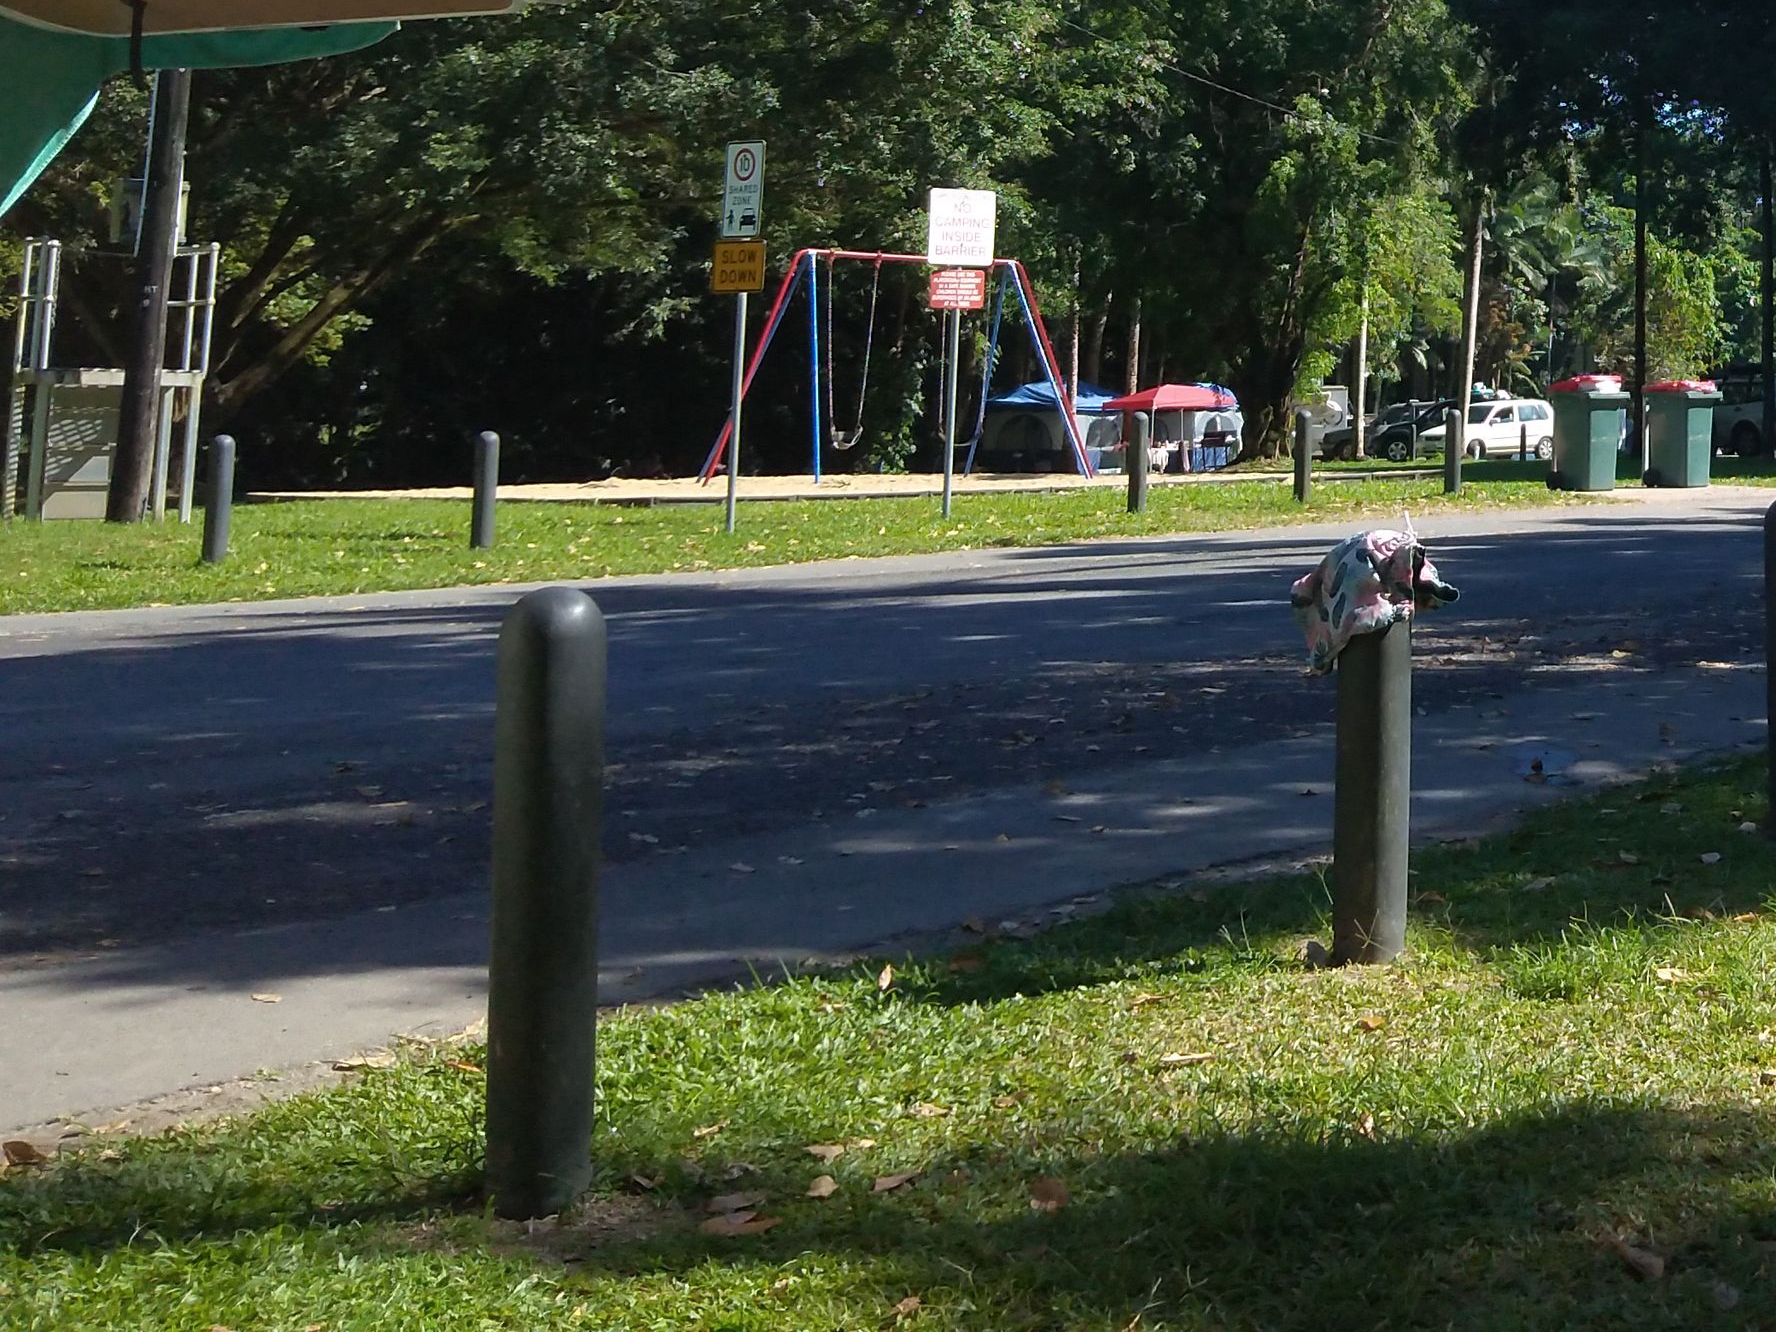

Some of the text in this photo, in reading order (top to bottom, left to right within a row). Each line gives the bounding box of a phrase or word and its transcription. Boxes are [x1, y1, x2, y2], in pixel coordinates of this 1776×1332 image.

[740, 155, 750, 172] 10
[729, 184, 758, 194] SHARED
[732, 196, 752, 206] ZONE
[954, 202, 972, 214] NO
[934, 216, 990, 229] CAMPING
[942, 230, 983, 242] INSIDE
[721, 250, 757, 264] SLOW
[935, 244, 986, 257] BARRIER
[720, 269, 757, 284] DOWN
